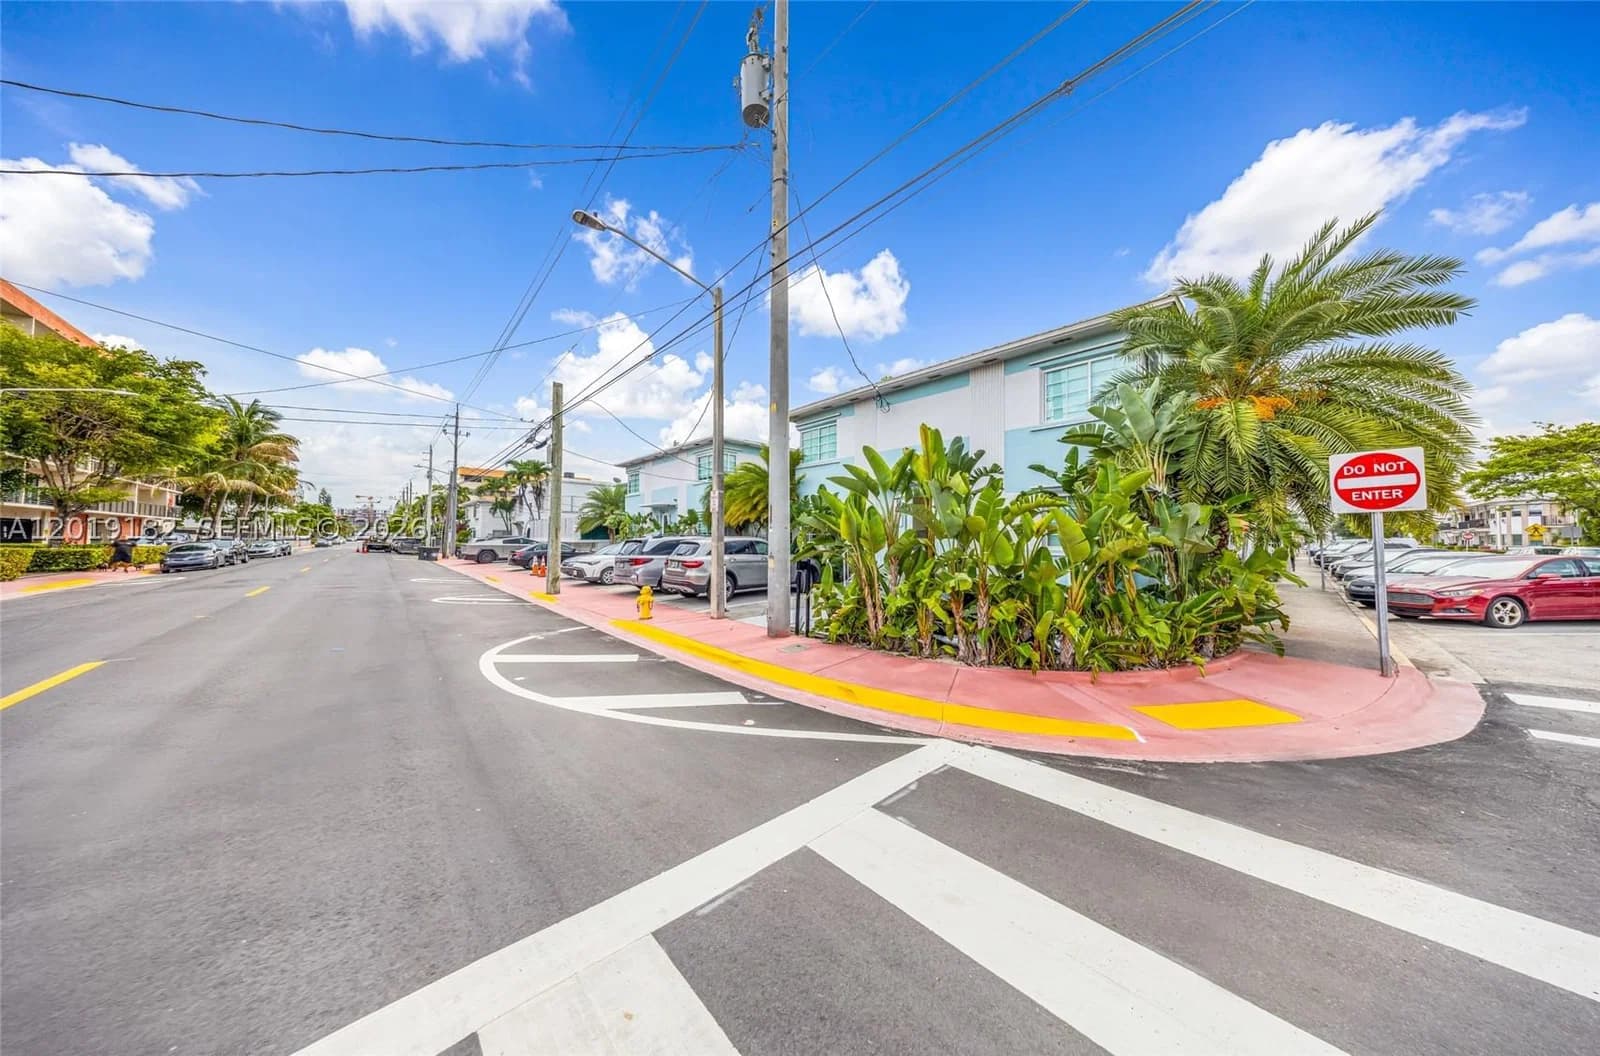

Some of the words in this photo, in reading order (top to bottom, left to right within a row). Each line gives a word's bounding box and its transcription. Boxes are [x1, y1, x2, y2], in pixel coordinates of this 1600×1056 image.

[1343, 465, 1366, 475] DO
[1373, 461, 1407, 473] NOT
[1351, 489, 1404, 501] ENTER
